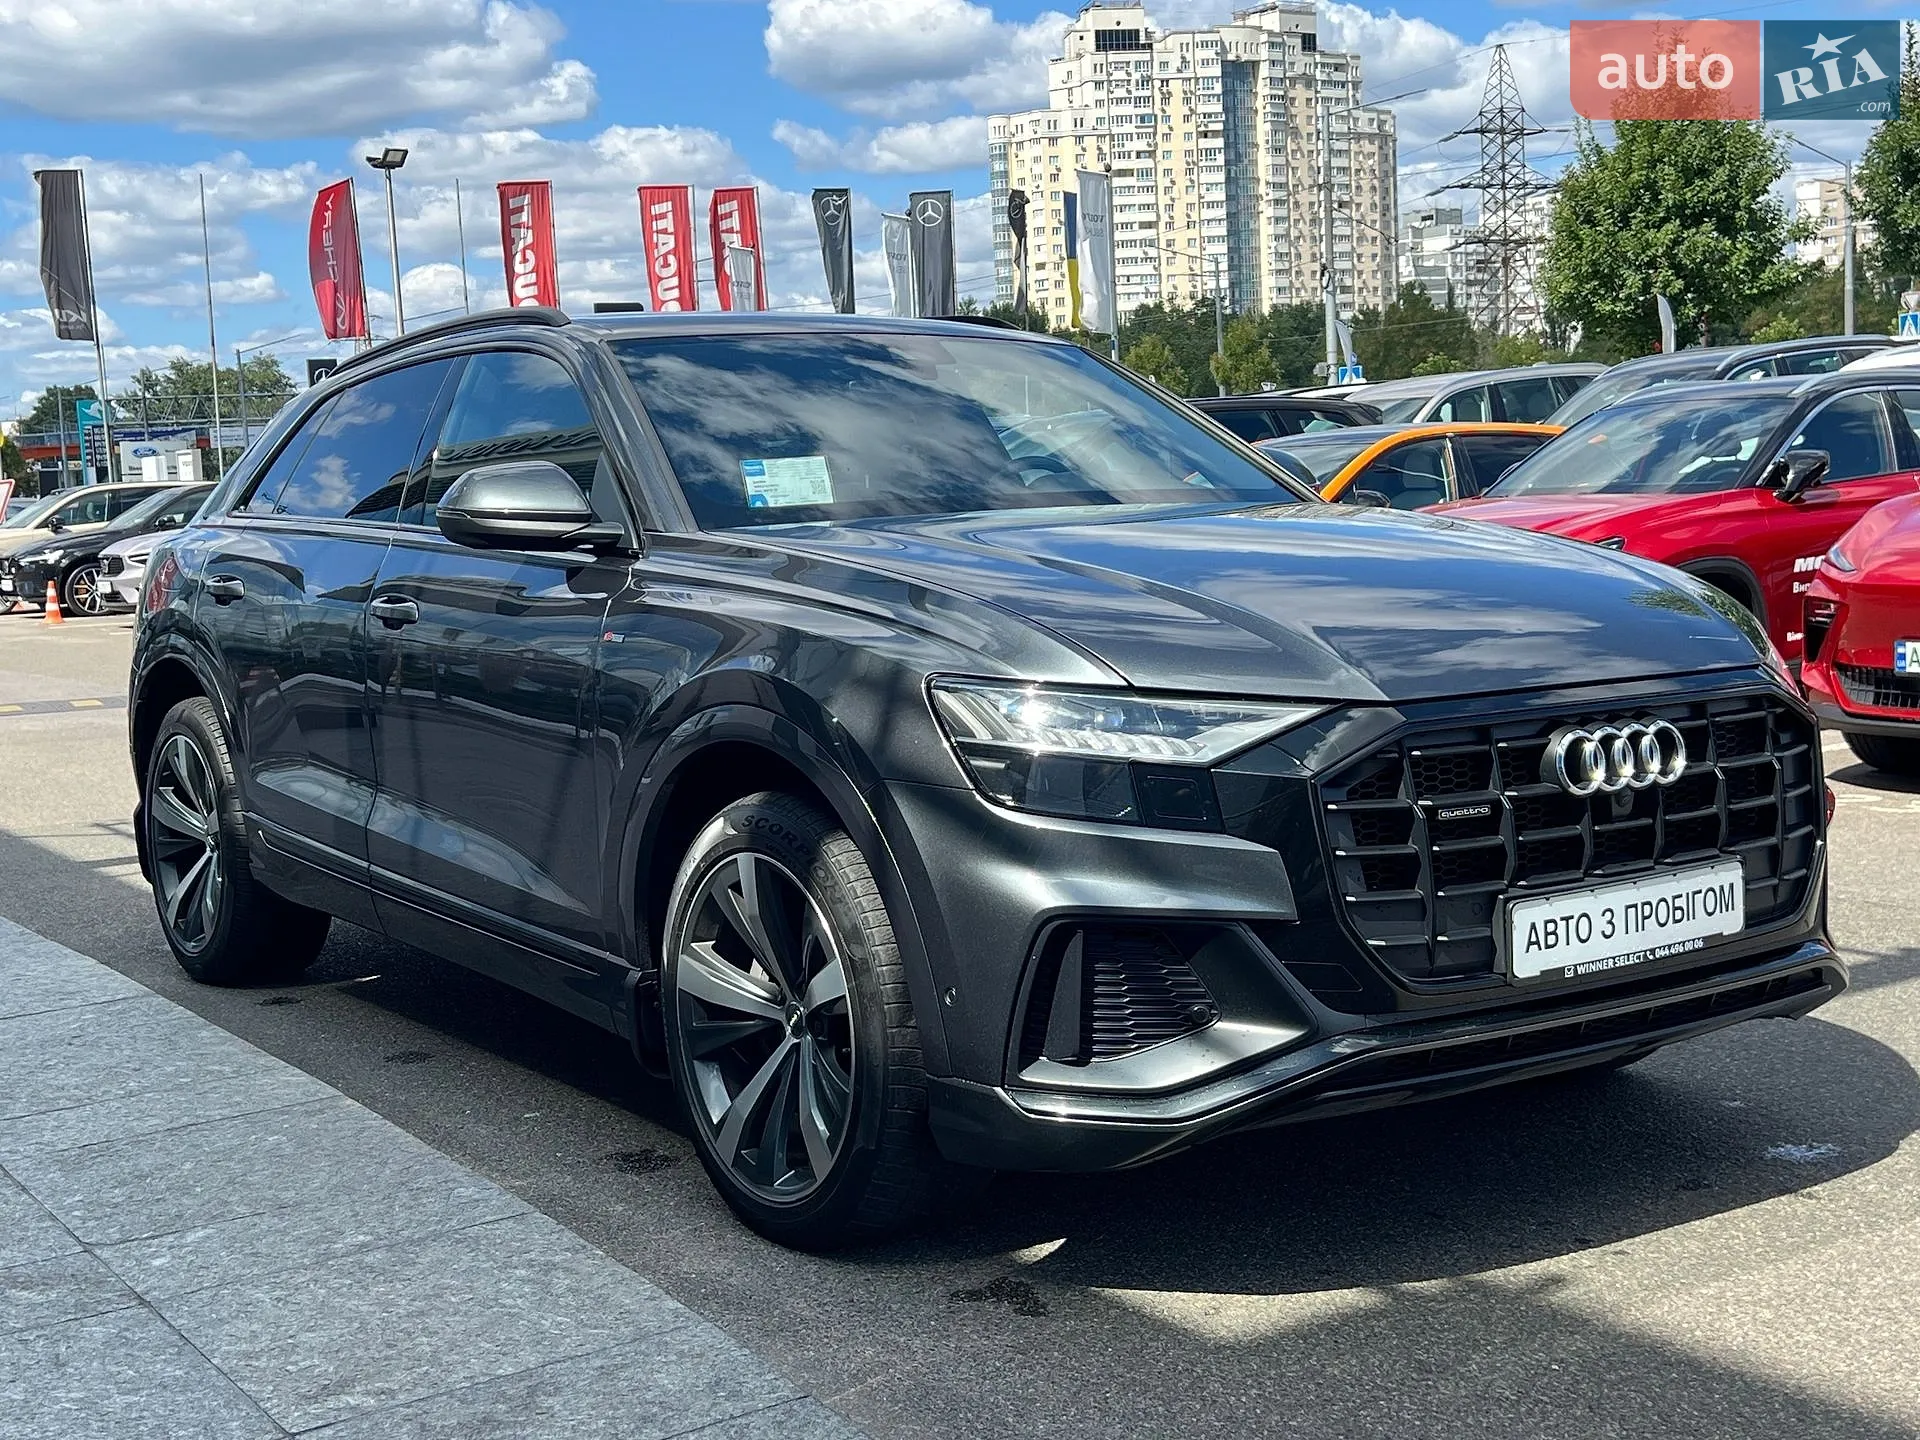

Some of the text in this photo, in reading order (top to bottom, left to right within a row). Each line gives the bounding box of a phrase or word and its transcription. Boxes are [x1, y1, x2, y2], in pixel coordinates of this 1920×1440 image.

[1441, 807, 1489, 819] quattro
[1524, 912, 1593, 954] АВТО
[1624, 882, 1736, 935] ПРОБІГОМ
[1576, 958, 1615, 975] WINNER
[1615, 951, 1646, 967] SELECT
